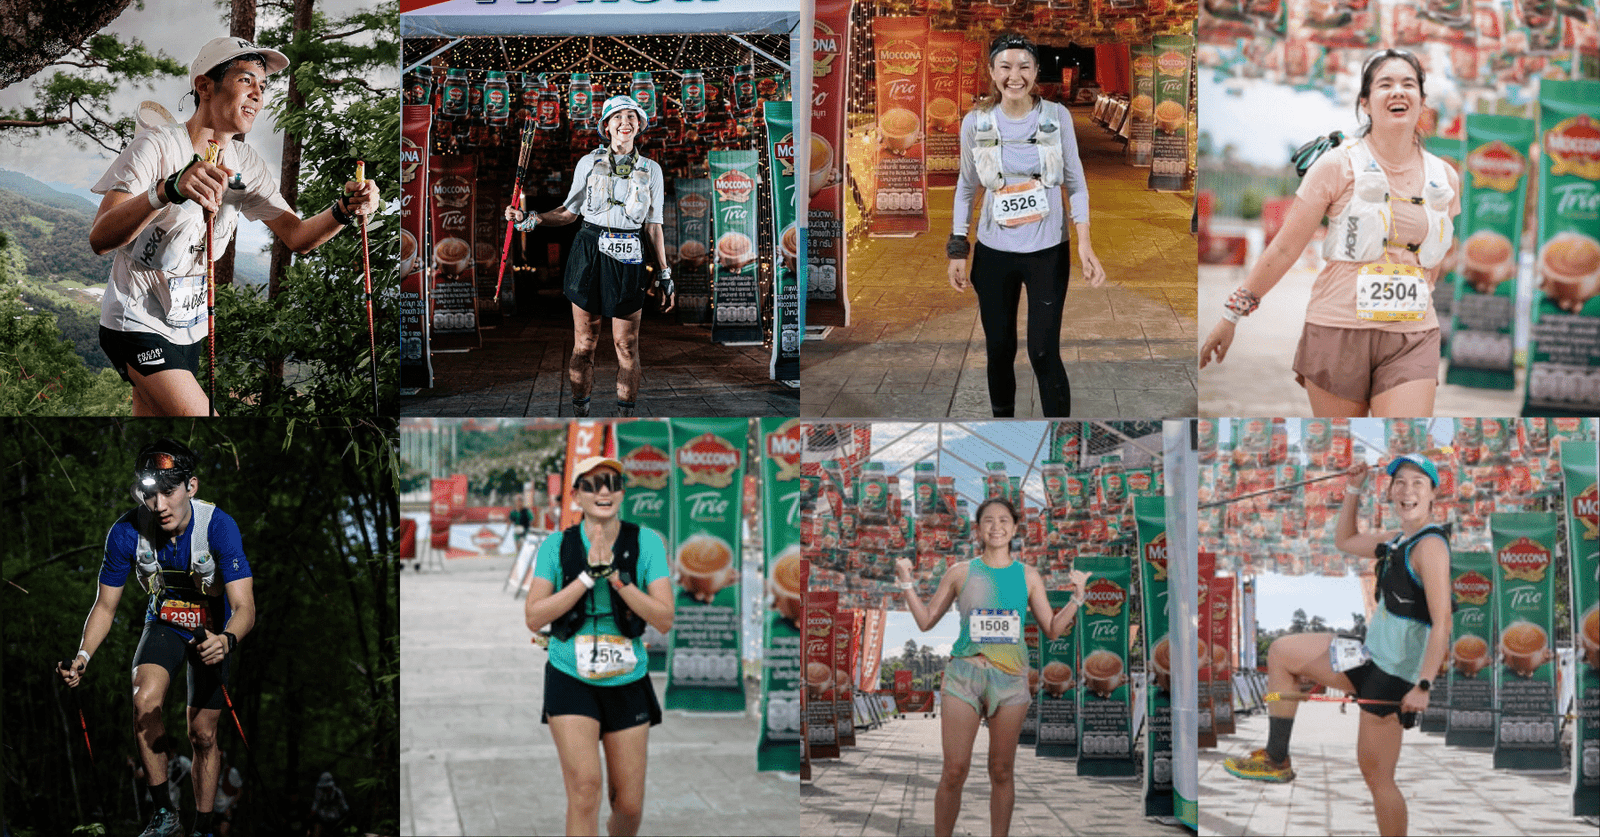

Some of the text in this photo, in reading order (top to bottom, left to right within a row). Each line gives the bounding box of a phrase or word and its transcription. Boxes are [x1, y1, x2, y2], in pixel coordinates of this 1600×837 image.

[880, 50, 921, 60] MOCCONA
[885, 78, 917, 98] Trio
[433, 185, 471, 194] MOCCONA
[717, 180, 753, 189] MOCCONA
[1001, 195, 1037, 212] 3526
[438, 210, 466, 228] Trio
[720, 205, 748, 223] Trio
[1345, 215, 1360, 259] HOKA
[140, 226, 167, 266] HOKA
[607, 243, 632, 253] 4515
[1370, 281, 1418, 301] 2504
[680, 449, 738, 465] MOCCONA
[685, 491, 729, 518] Trio
[1500, 553, 1549, 564] MOCCONA
[1506, 585, 1543, 608] Trio
[170, 611, 200, 623] 2991
[980, 620, 1009, 631] 1508
[1087, 619, 1120, 639] Trio
[589, 648, 625, 663] 2512
